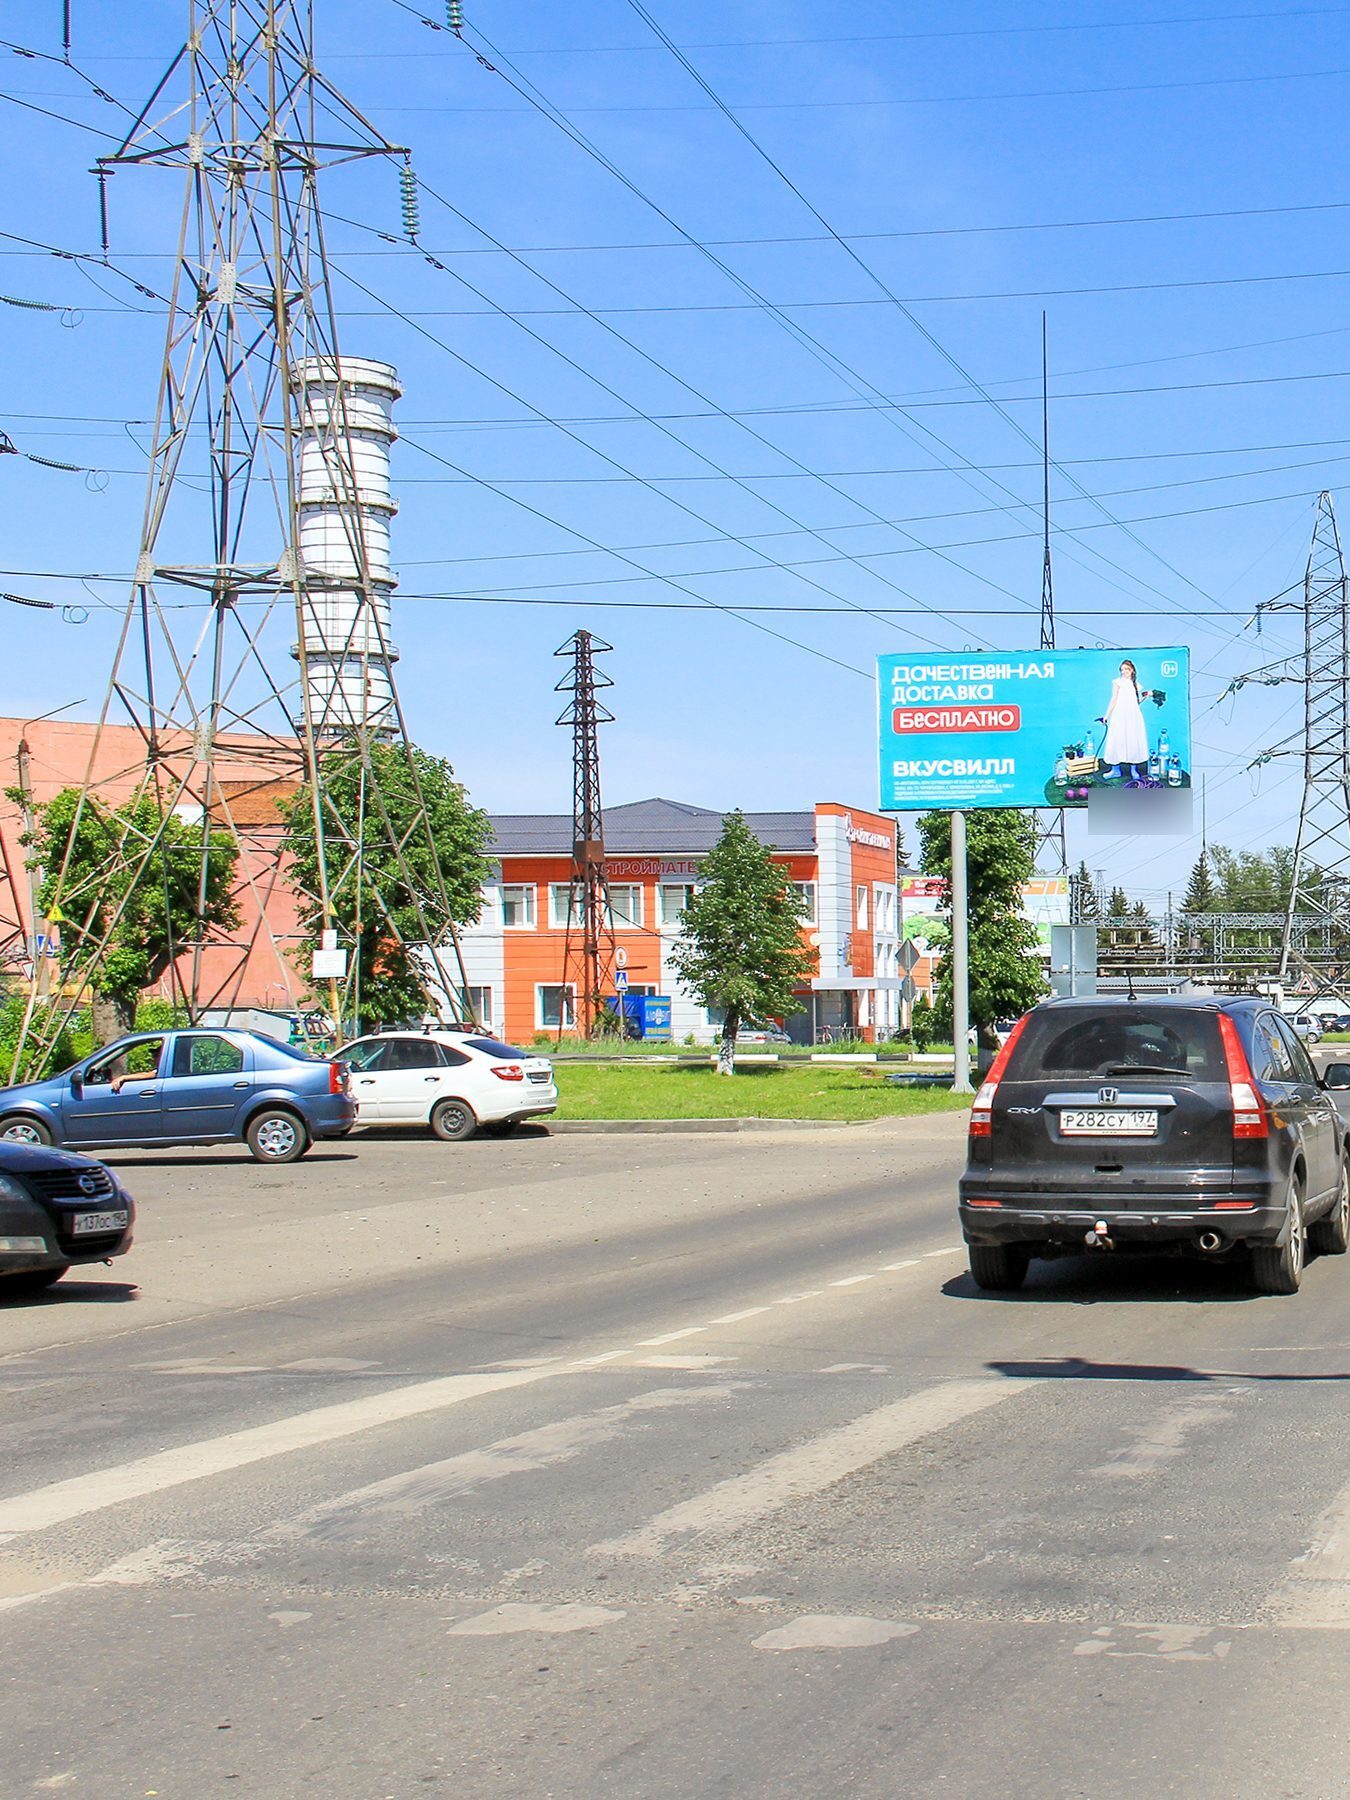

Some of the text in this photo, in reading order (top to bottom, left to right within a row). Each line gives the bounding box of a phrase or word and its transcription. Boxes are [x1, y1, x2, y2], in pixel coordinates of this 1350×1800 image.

[892, 758, 1015, 777] ВКУСВИЛЛ
[600, 859, 697, 875] СТРОЙМАТЕ
[1130, 1110, 1153, 1123] 197
